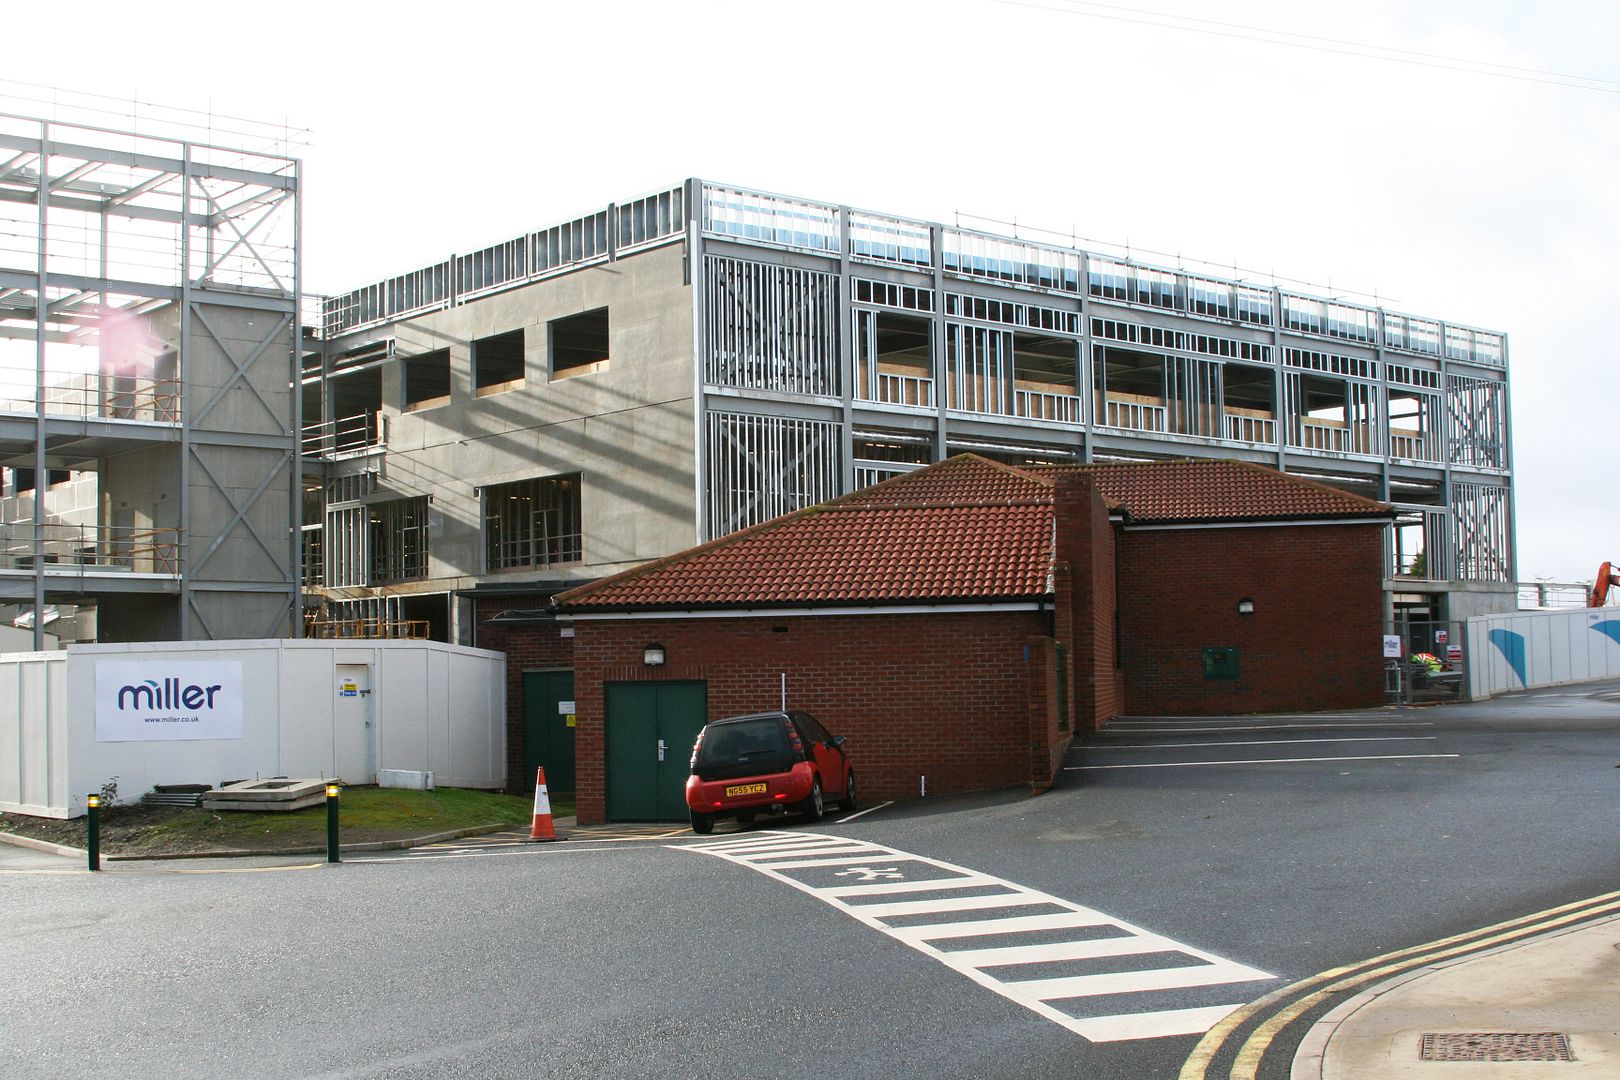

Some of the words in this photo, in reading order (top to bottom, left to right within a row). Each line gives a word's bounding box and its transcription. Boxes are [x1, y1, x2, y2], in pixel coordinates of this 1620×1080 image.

[118, 677, 221, 710] miller
[144, 715, 199, 723] www.miller.co.uk
[728, 786, 748, 796] NG55
